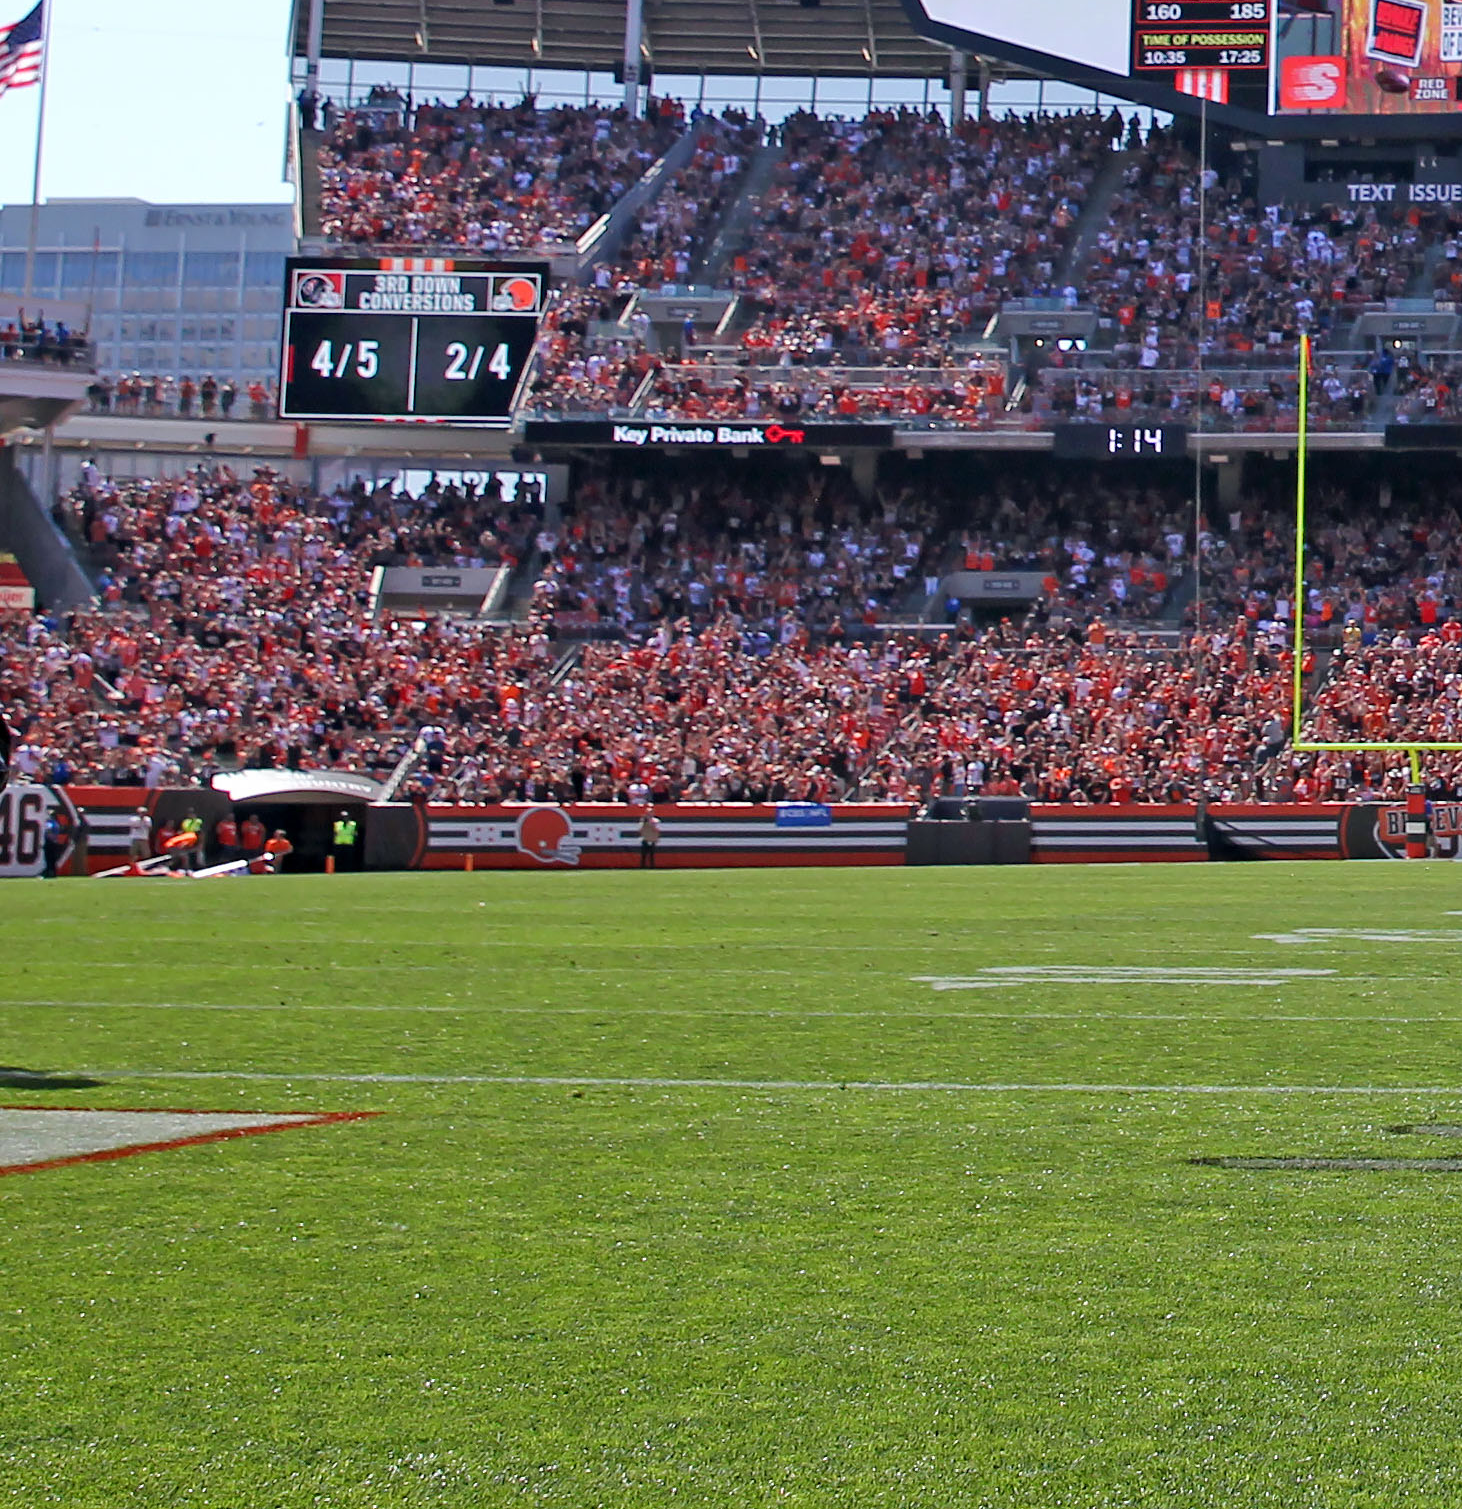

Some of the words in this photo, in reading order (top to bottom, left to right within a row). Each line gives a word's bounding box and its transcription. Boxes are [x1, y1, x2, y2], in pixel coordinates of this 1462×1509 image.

[1146, 3, 1182, 20] 160
[1230, 3, 1265, 19] 185
[1142, 34, 1171, 46] TIME
[1172, 34, 1189, 46] OF
[1190, 34, 1265, 46] POSSESSION
[1144, 51, 1186, 64] 10:35
[1219, 50, 1261, 63] 17:25
[1418, 78, 1445, 89] RED
[1414, 89, 1449, 100] ZONE
[1346, 184, 1396, 201] TEXT
[375, 275, 409, 293] 3RD
[412, 276, 461, 294] DOWN
[358, 292, 475, 311] CONVERSIONS
[311, 339, 379, 379] 4/5
[444, 342, 511, 380] 2/4
[613, 425, 648, 445] Key
[650, 425, 714, 443] Private
[717, 426, 764, 444] Bank
[1109, 429, 1162, 452] 1:14
